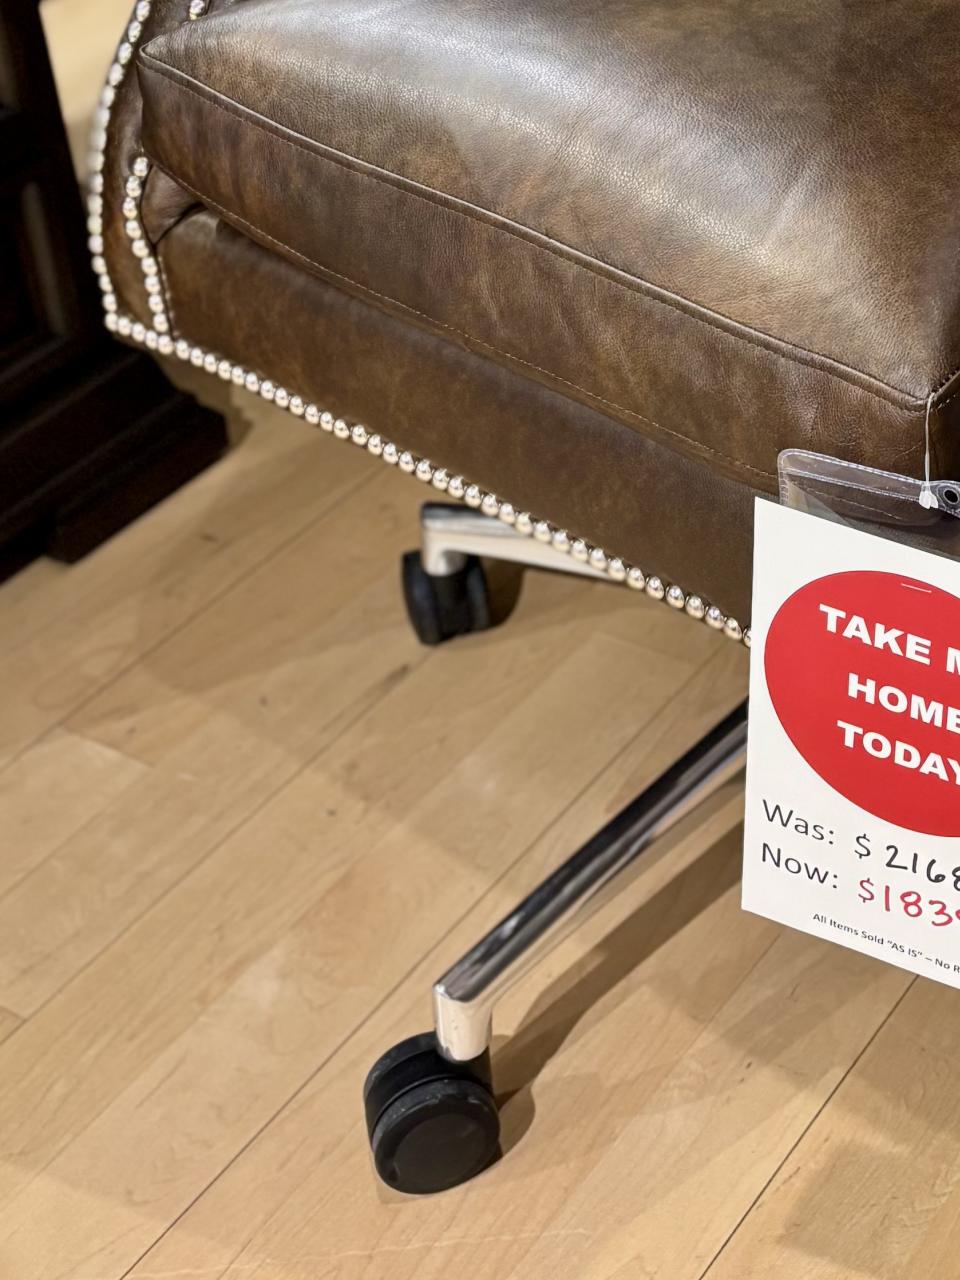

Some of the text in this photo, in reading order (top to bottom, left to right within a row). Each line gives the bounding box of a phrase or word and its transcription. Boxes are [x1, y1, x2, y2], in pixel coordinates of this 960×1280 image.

[819, 603, 932, 666] TAKE
[762, 799, 835, 845] Was:
[761, 842, 838, 889] Now:
[812, 913, 827, 924] All
[829, 918, 859, 936] Items
[861, 930, 884, 945] Sold
[934, 958, 950, 969] No
